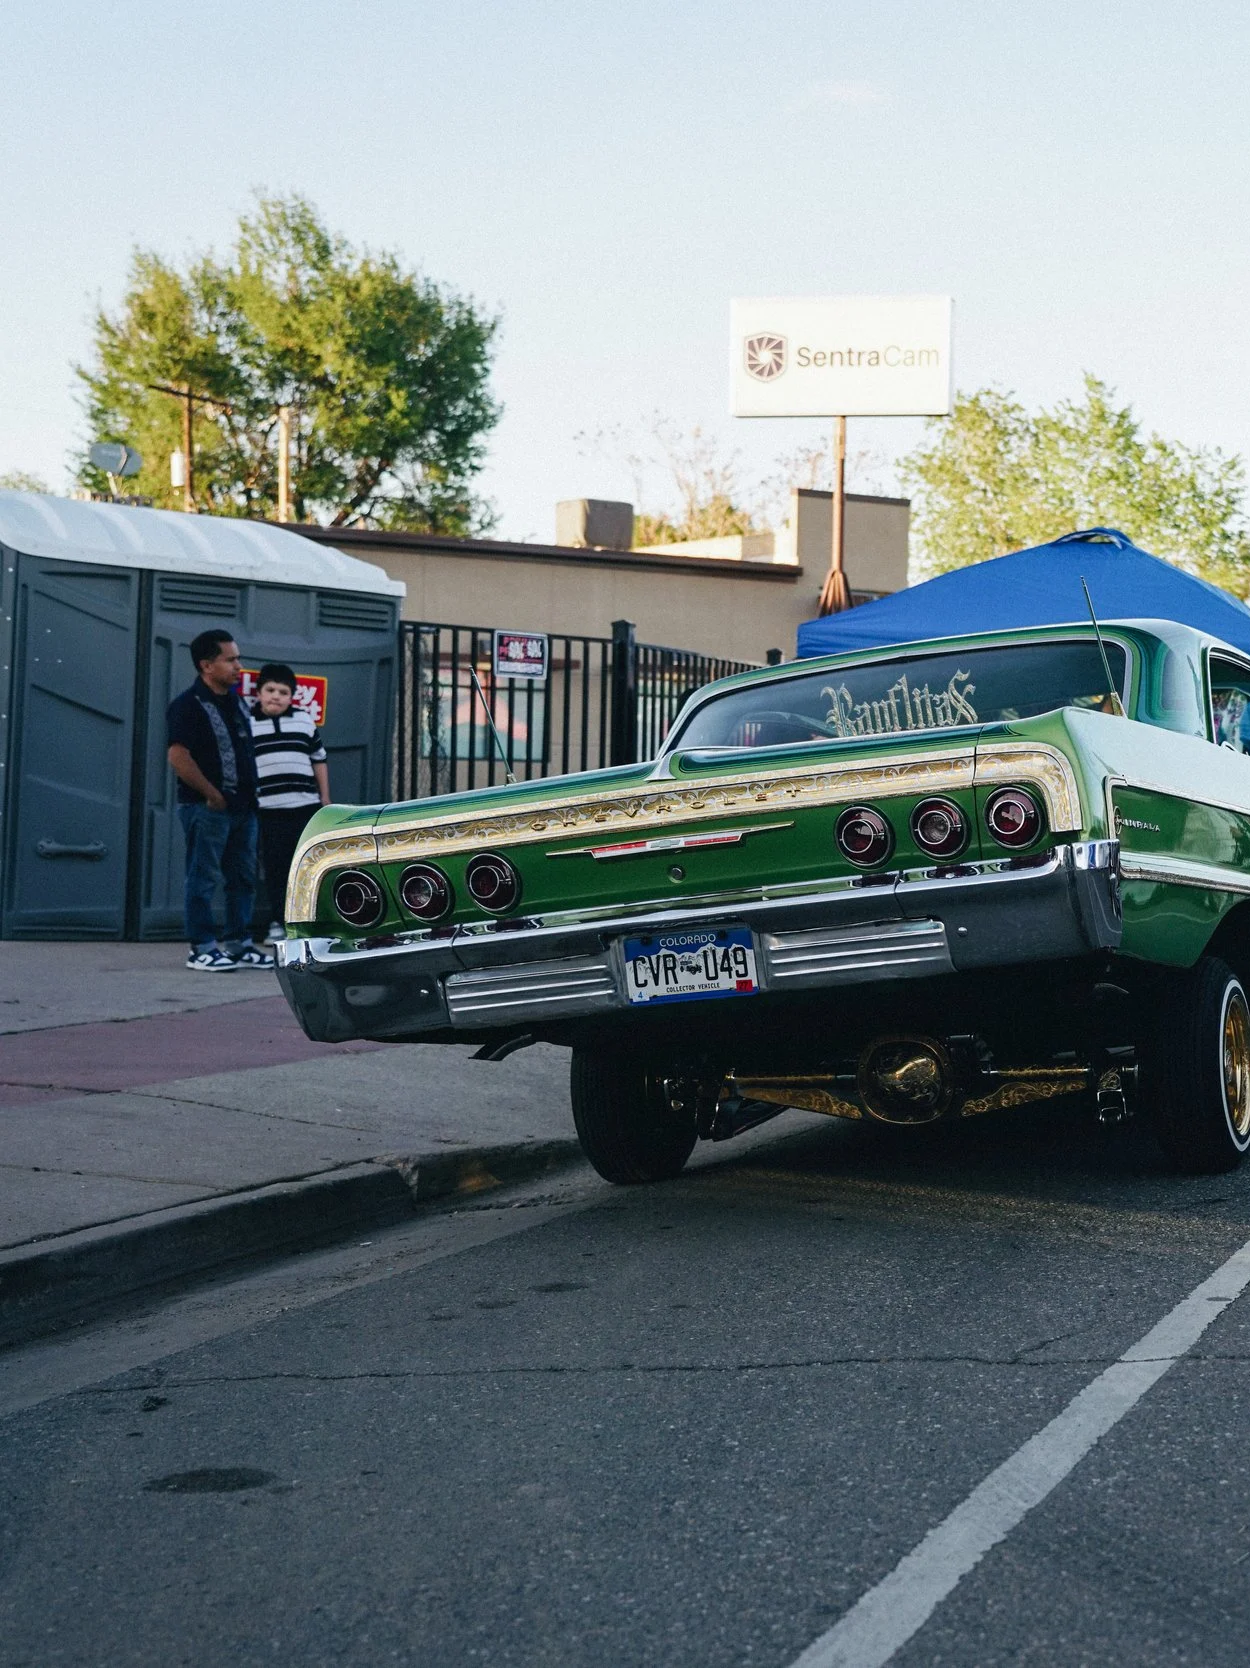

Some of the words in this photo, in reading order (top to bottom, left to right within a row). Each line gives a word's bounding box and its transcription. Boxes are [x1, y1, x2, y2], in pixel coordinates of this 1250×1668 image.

[797, 345, 939, 367] SentraCam
[659, 934, 717, 947] COLORADO
[632, 953, 679, 988] CVR
[666, 984, 696, 993] COLLECTOR
[697, 982, 720, 991] VEHICLE
[637, 991, 643, 999] 4
